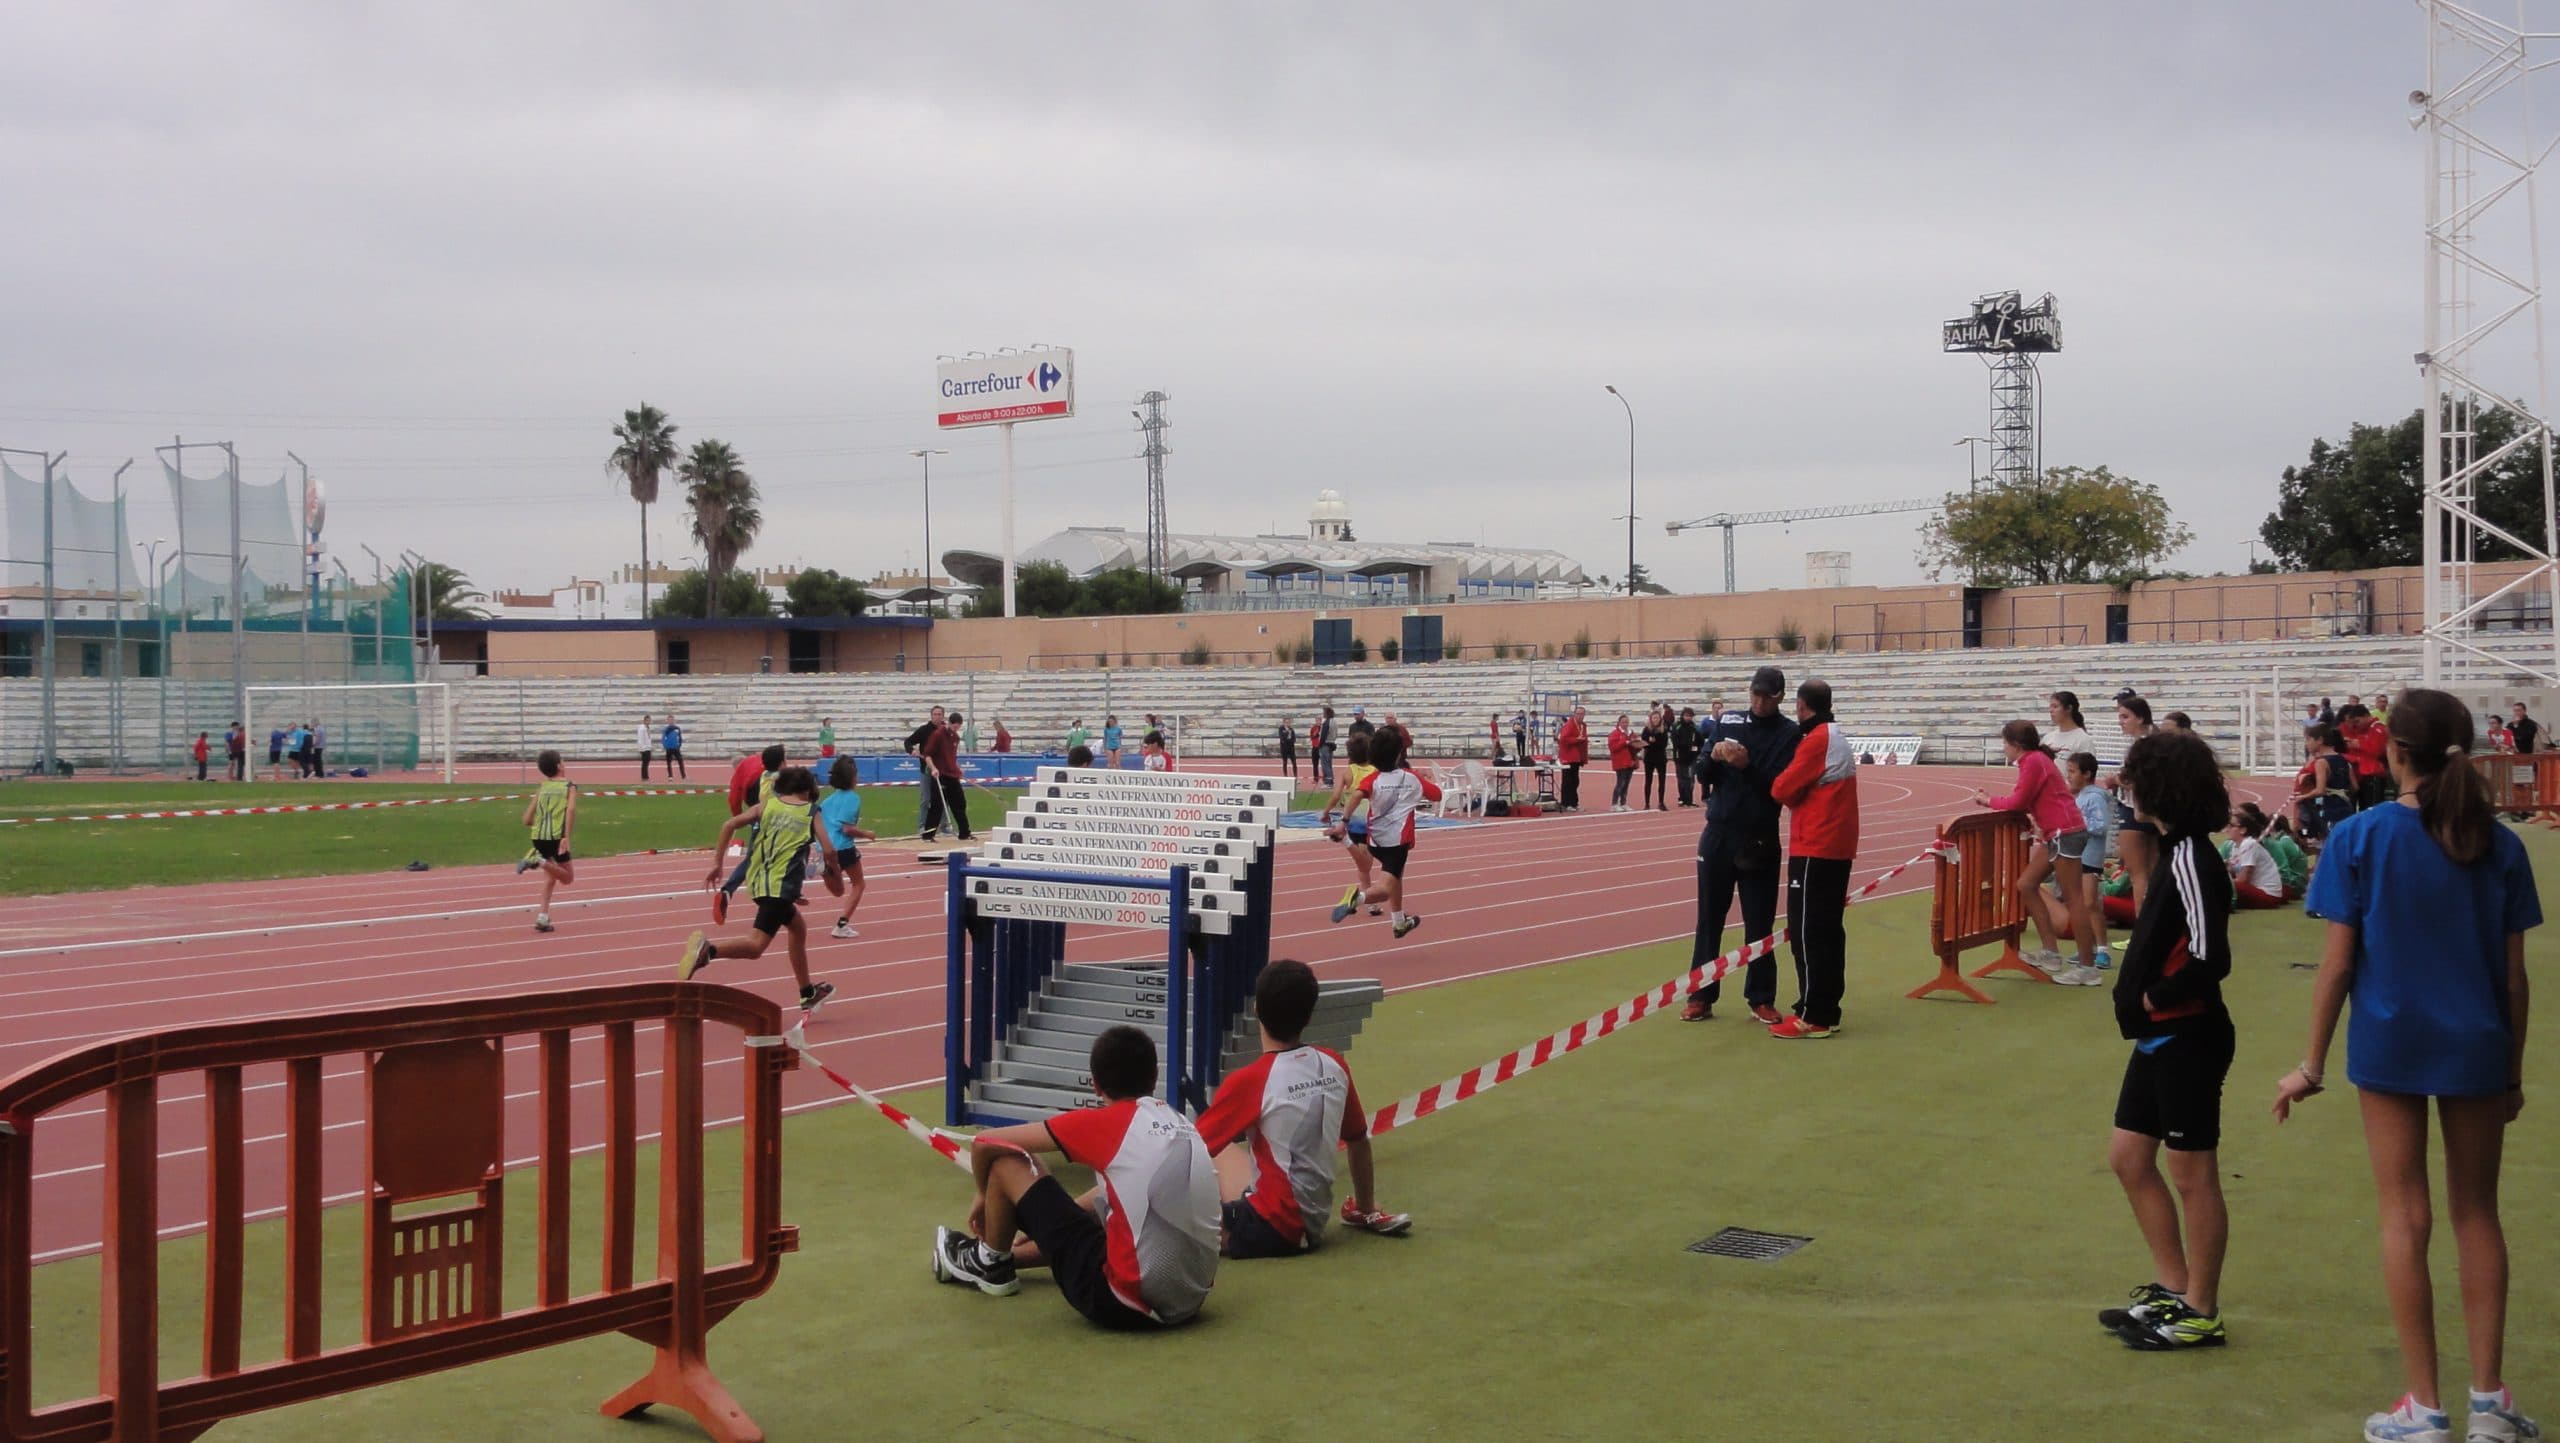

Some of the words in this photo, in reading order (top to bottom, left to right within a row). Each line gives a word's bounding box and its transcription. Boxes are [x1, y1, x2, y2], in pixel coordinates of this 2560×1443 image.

[942, 373, 1022, 398] Carrefour
[957, 413, 981, 422] Abierto
[1098, 790, 1118, 800] SAN
[1121, 791, 1182, 803] FERNANDO
[1186, 794, 1212, 804] 2010
[1086, 805, 1107, 816] SAN
[1110, 806, 1170, 819] FERNANDO
[1175, 809, 1201, 820] 2010
[1074, 820, 1095, 832] SAN
[1098, 822, 1160, 836] FERNANDO
[1163, 825, 1190, 836] 2010
[1061, 836, 1082, 848] SAN
[1084, 837, 1147, 852] FERNANDO
[1151, 842, 1178, 853] 2010
[1021, 852, 1044, 861] UCS
[1052, 852, 1073, 864] SAN
[1076, 853, 1136, 868] FERNANDO
[1141, 858, 1168, 870] 2010
[996, 886, 1024, 895] UCS
[1032, 884, 1056, 898] SAN
[1058, 886, 1126, 902] FERNANDO
[1130, 892, 1160, 905] 2010
[986, 904, 1012, 912] UCS
[1020, 903, 1042, 916] SAN
[1045, 904, 1112, 921] FERNANDO
[1116, 910, 1146, 924] 2010
[1151, 915, 1171, 924] UC
[1136, 976, 1166, 986] UCS
[1136, 992, 1166, 1003] UCS
[1124, 1008, 1155, 1019] UCS
